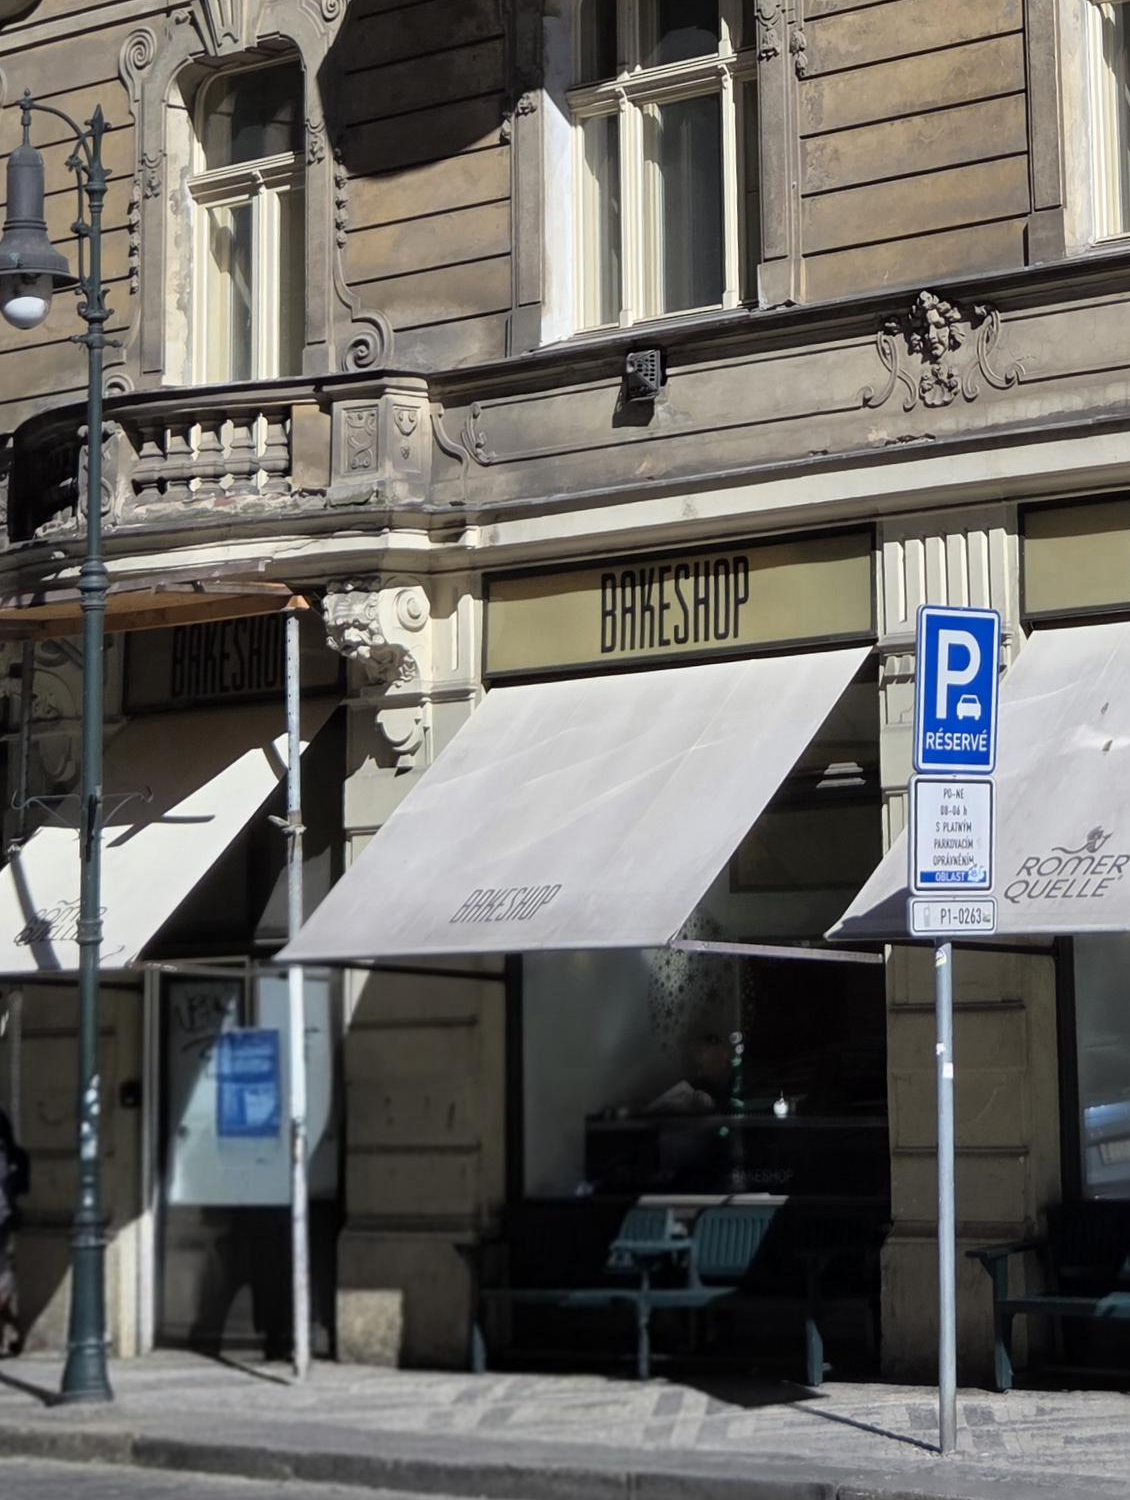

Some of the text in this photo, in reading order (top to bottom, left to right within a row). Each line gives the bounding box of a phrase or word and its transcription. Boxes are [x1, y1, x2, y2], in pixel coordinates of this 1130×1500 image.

[600, 555, 749, 654] BAKESHOP
[172, 613, 285, 698] BAKESHO
[936, 629, 981, 719] P
[925, 727, 988, 752] RÉSERVÉ
[943, 788, 965, 799] PO-NE
[935, 819, 973, 833] S PLATNÝM
[935, 871, 966, 883] OBLAST
[448, 884, 563, 923] BAKESHOP
[1003, 877, 1116, 904] QUELLE
[940, 907, 982, 925] P1-0263
